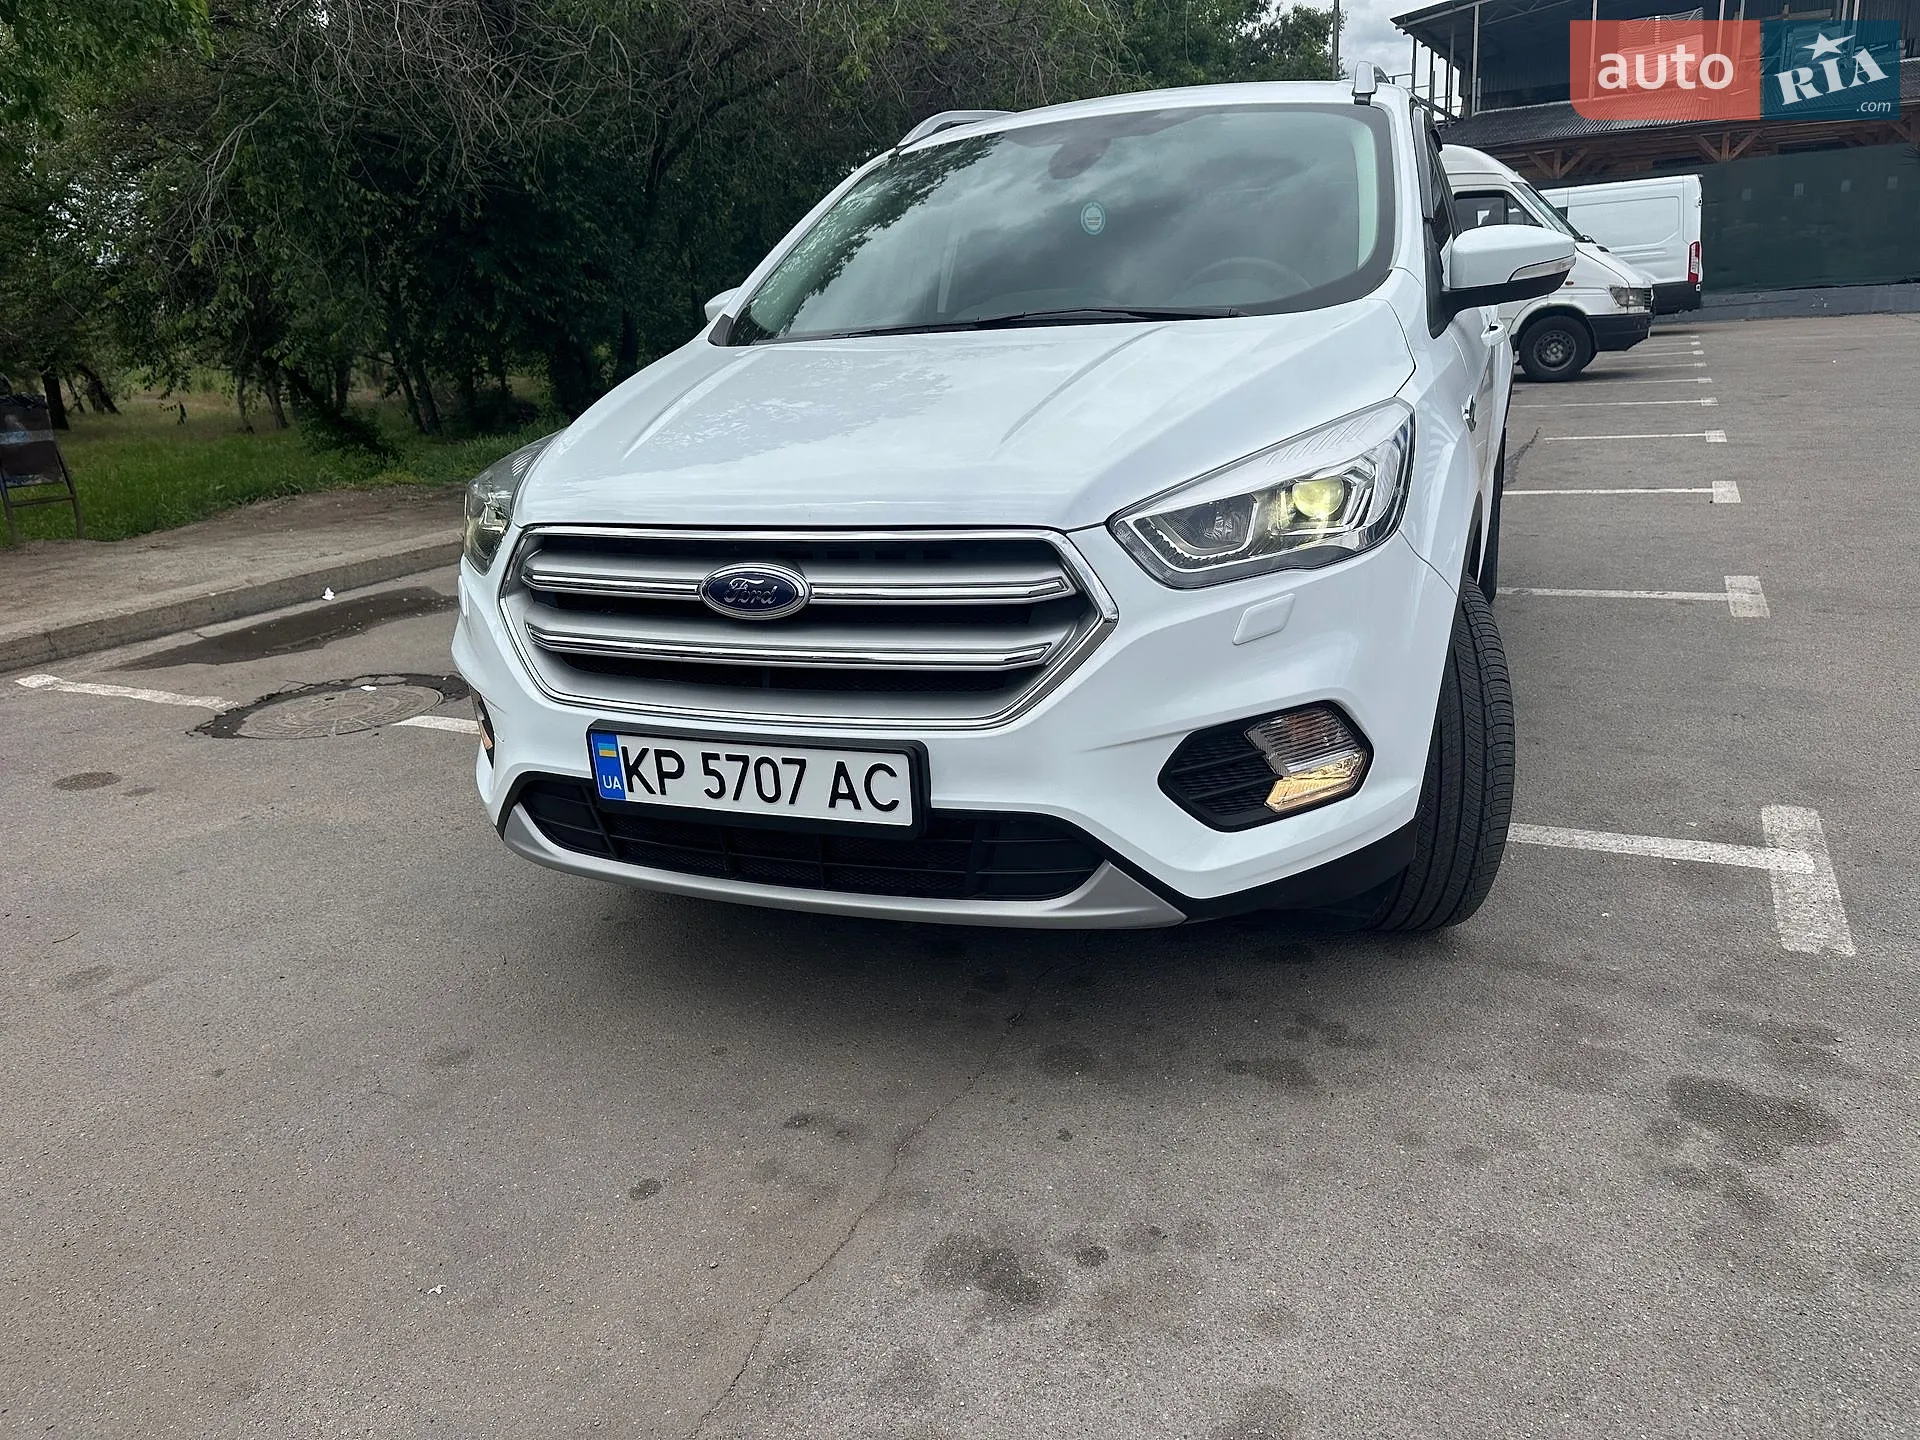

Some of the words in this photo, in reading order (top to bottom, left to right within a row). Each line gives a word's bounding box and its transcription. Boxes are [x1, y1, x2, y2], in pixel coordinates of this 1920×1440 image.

[724, 577, 778, 604] Ford
[602, 774, 621, 791] UA
[620, 745, 685, 795] KP
[700, 751, 807, 805] 5707
[828, 760, 900, 812] AC
